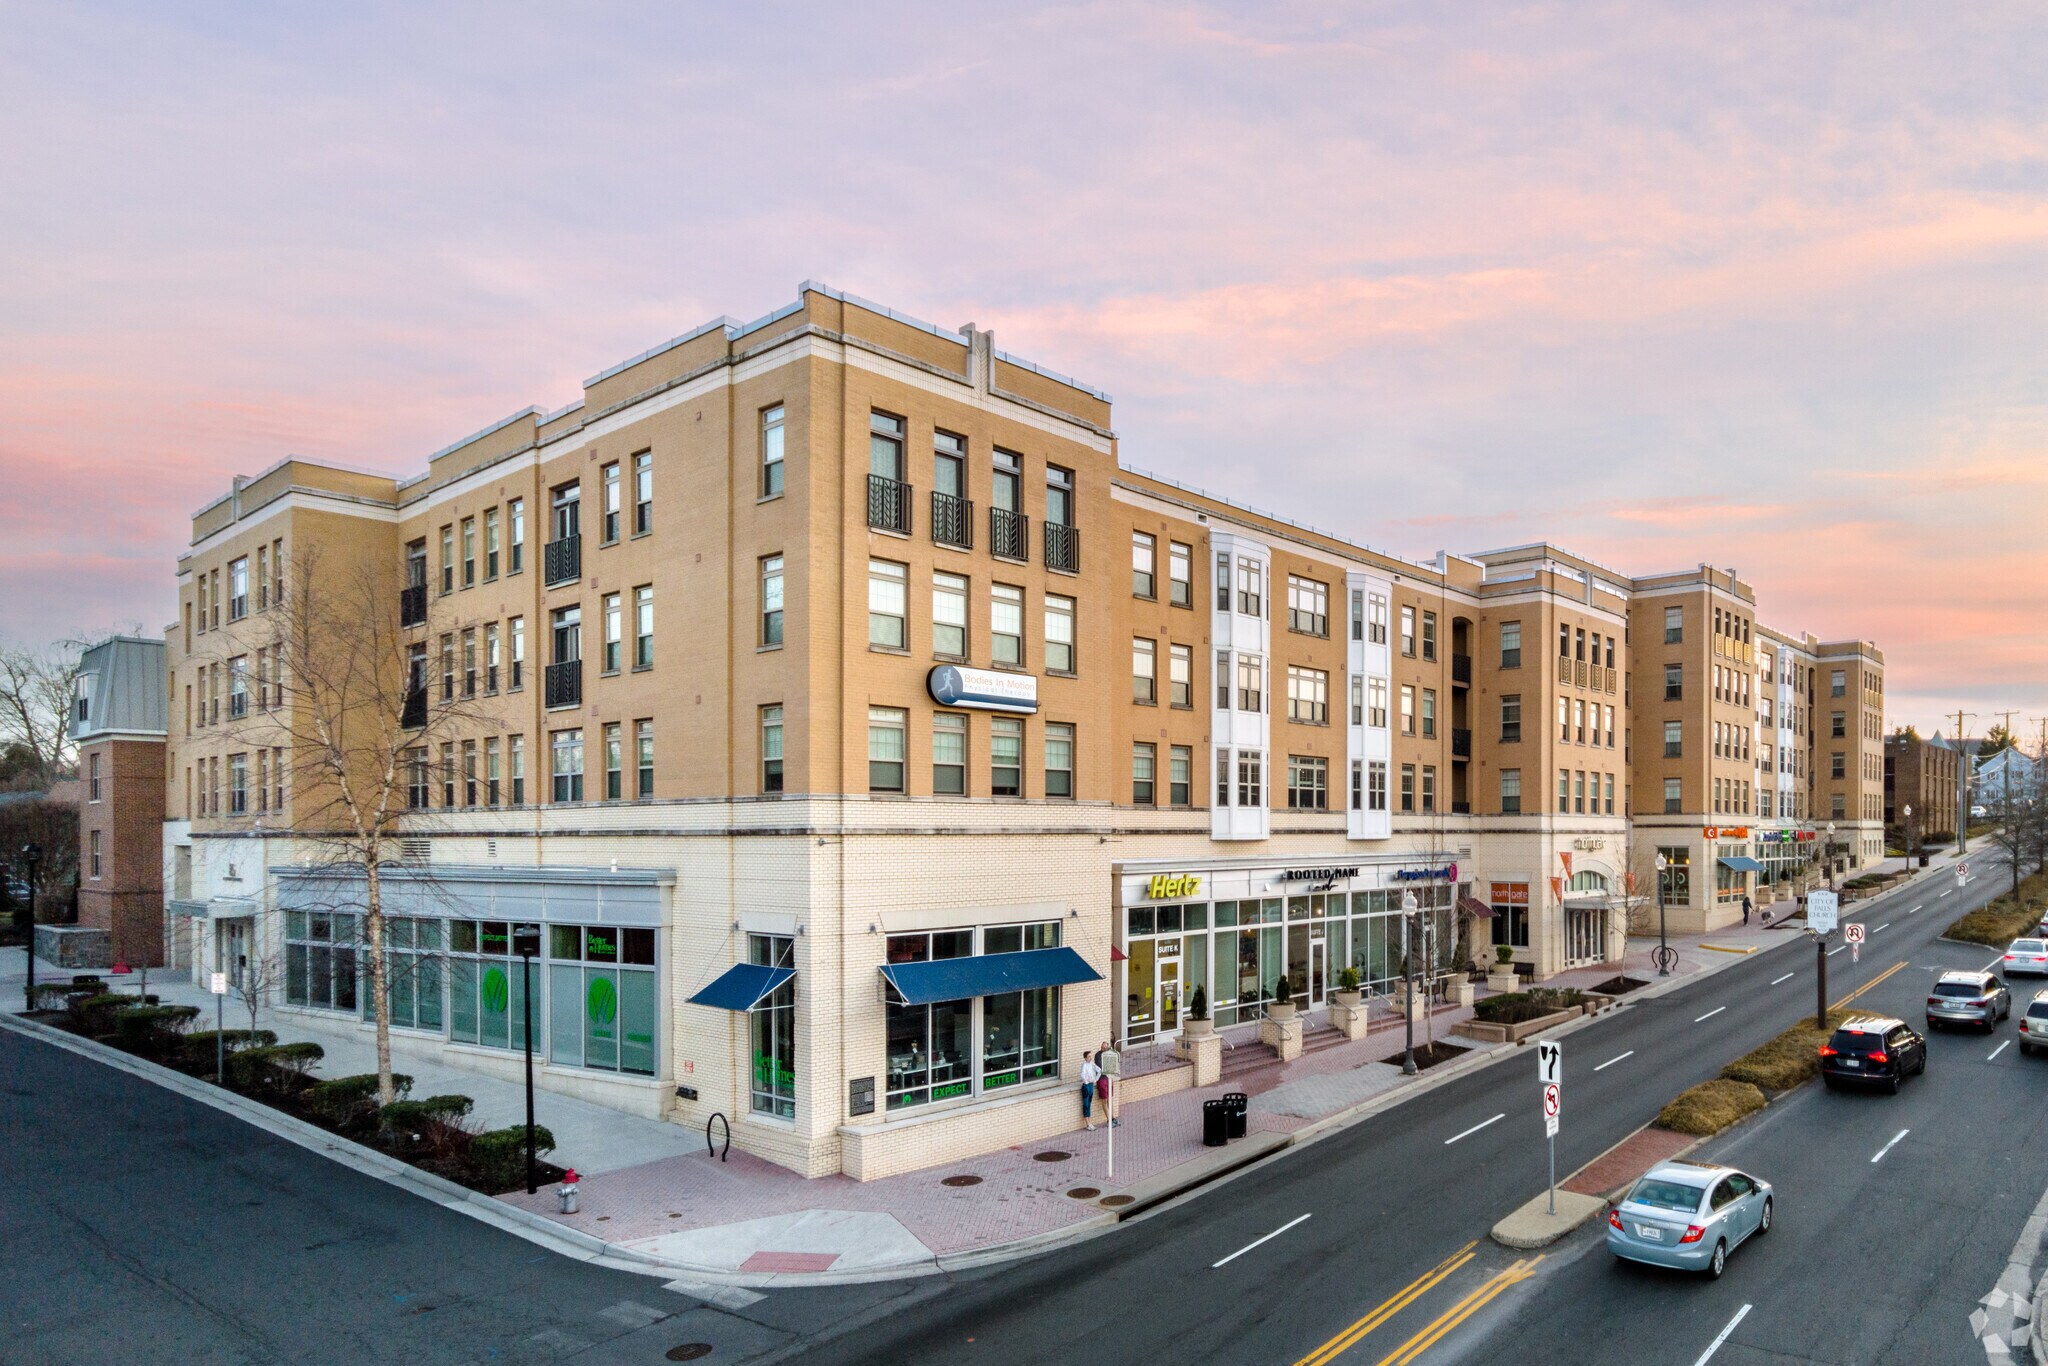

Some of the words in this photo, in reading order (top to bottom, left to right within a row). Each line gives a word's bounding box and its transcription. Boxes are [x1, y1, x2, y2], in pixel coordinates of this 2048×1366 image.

[965, 674, 992, 685] Bodies
[1007, 680, 1035, 690] Motion
[965, 684, 998, 693] Physical
[1286, 868, 1331, 880] ROOTED
[1335, 867, 1360, 878] MANE
[1149, 874, 1202, 899] Hertz
[588, 934, 607, 944] Better
[594, 943, 616, 953] Homes
[1158, 945, 1174, 954] SUITE
[1174, 944, 1179, 952] K
[933, 1083, 967, 1099] EXPECT
[985, 1073, 1017, 1088] BETTER
